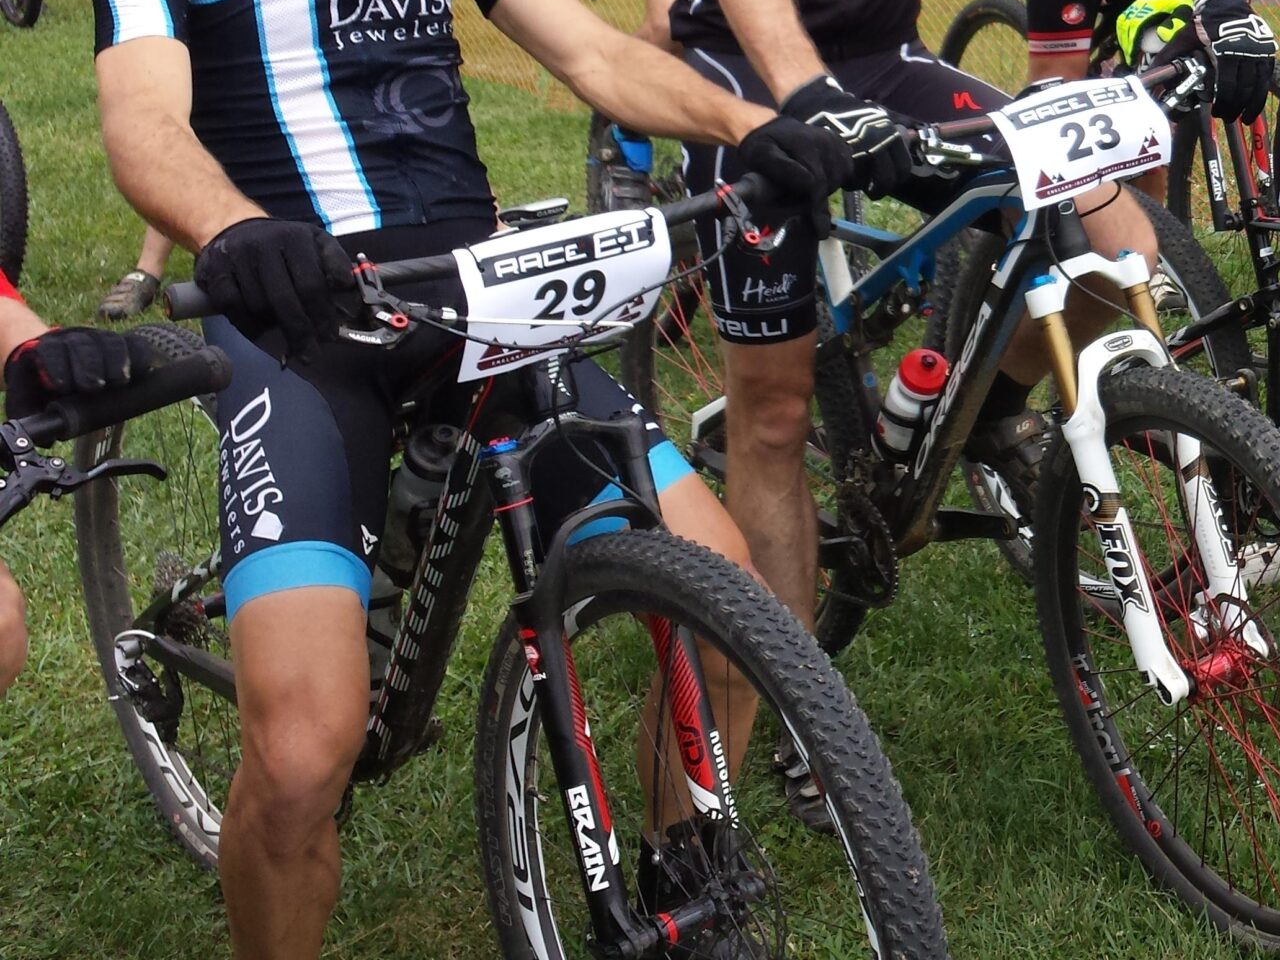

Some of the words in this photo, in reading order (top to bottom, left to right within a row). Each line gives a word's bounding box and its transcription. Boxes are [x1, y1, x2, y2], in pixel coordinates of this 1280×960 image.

[1018, 96, 1088, 125] RACE
[1060, 113, 1122, 162] 23
[1208, 159, 1224, 202] BRAIN
[493, 243, 587, 278] RACE
[530, 269, 607, 330] 29
[230, 386, 284, 517] DAVIS
[219, 429, 246, 555] Jewelers
[1095, 522, 1150, 614] FOX
[567, 783, 610, 892] BRAIN
